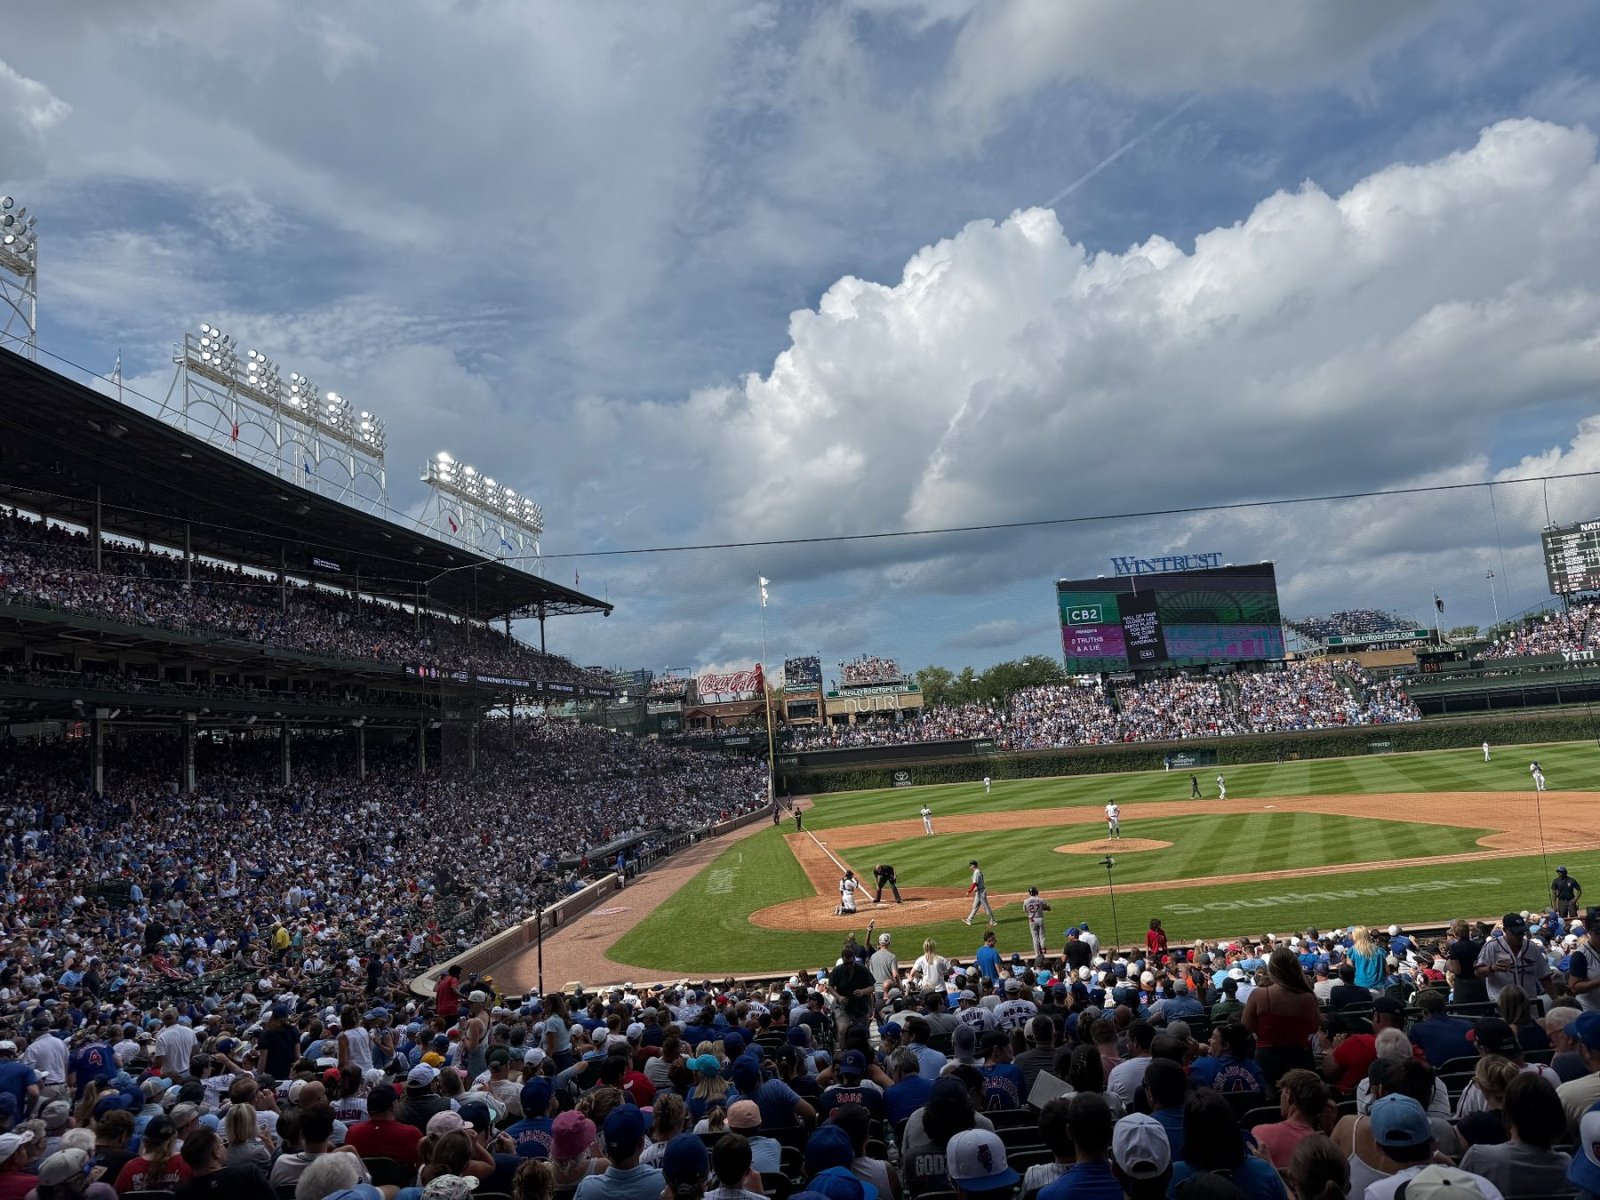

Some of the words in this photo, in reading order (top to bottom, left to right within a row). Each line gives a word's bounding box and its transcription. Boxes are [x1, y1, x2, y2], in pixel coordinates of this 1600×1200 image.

[1111, 552, 1222, 575] WINTRUST
[1071, 609, 1097, 620] CB2
[1077, 636, 1104, 644] TRUTHS
[1342, 631, 1415, 643] WRIGLEYROOFTOPS.COM
[1561, 650, 1594, 661] YETI
[700, 671, 757, 694] Coca-Cola
[838, 685, 909, 697] WRIGLEYROOFTOPS.COM
[1029, 904, 1040, 913] 27
[89, 1048, 104, 1066] 4
